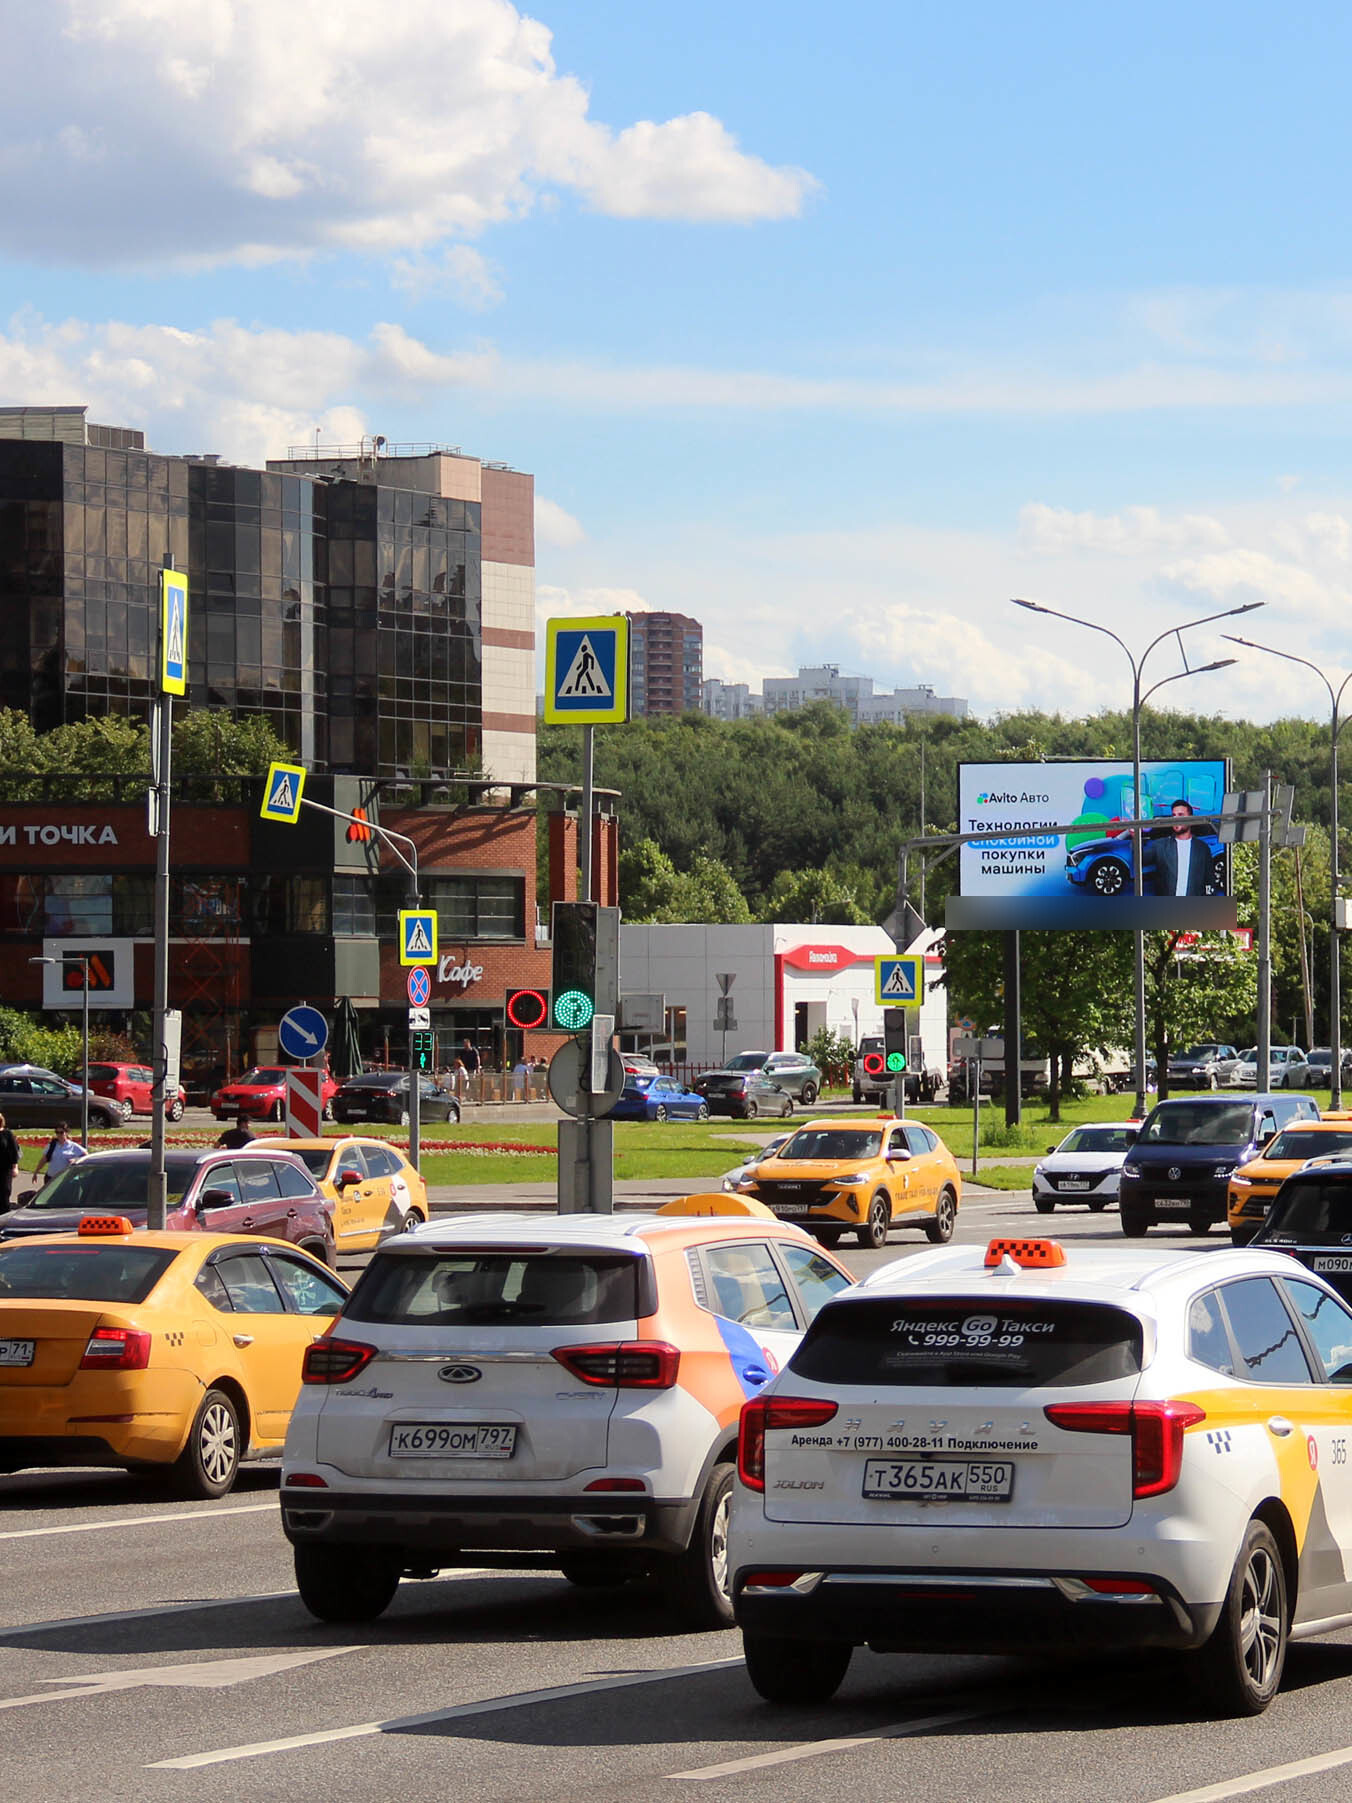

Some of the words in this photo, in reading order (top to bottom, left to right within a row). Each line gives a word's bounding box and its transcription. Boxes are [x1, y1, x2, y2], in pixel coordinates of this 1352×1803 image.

[989, 792, 1018, 803] Avito
[1020, 792, 1049, 803] Авто
[24, 825, 119, 845] ТОЧКА
[982, 850, 1045, 863] покупки
[981, 865, 1045, 874] машины
[439, 955, 484, 988] Кафе
[415, 1032, 432, 1051] 33
[890, 1319, 958, 1333] Яндекс
[964, 1318, 993, 1333] Go
[1001, 1319, 1055, 1333] Такси
[923, 1334, 1024, 1347] 999-99-99
[14, 1343, 27, 1357] 71
[398, 1428, 476, 1449] К699ОМ
[480, 1428, 510, 1444] 797
[791, 1435, 833, 1446] Аренда
[837, 1437, 850, 1447] +7
[854, 1437, 883, 1450] (977)
[887, 1437, 943, 1448] 400-28-11
[948, 1437, 1038, 1450] Подключение
[1309, 1438, 1317, 1466] Я
[1331, 1439, 1347, 1465] 365
[874, 1466, 963, 1490] Т365АК
[969, 1466, 1005, 1484] 550
[980, 1484, 999, 1492] RUS
